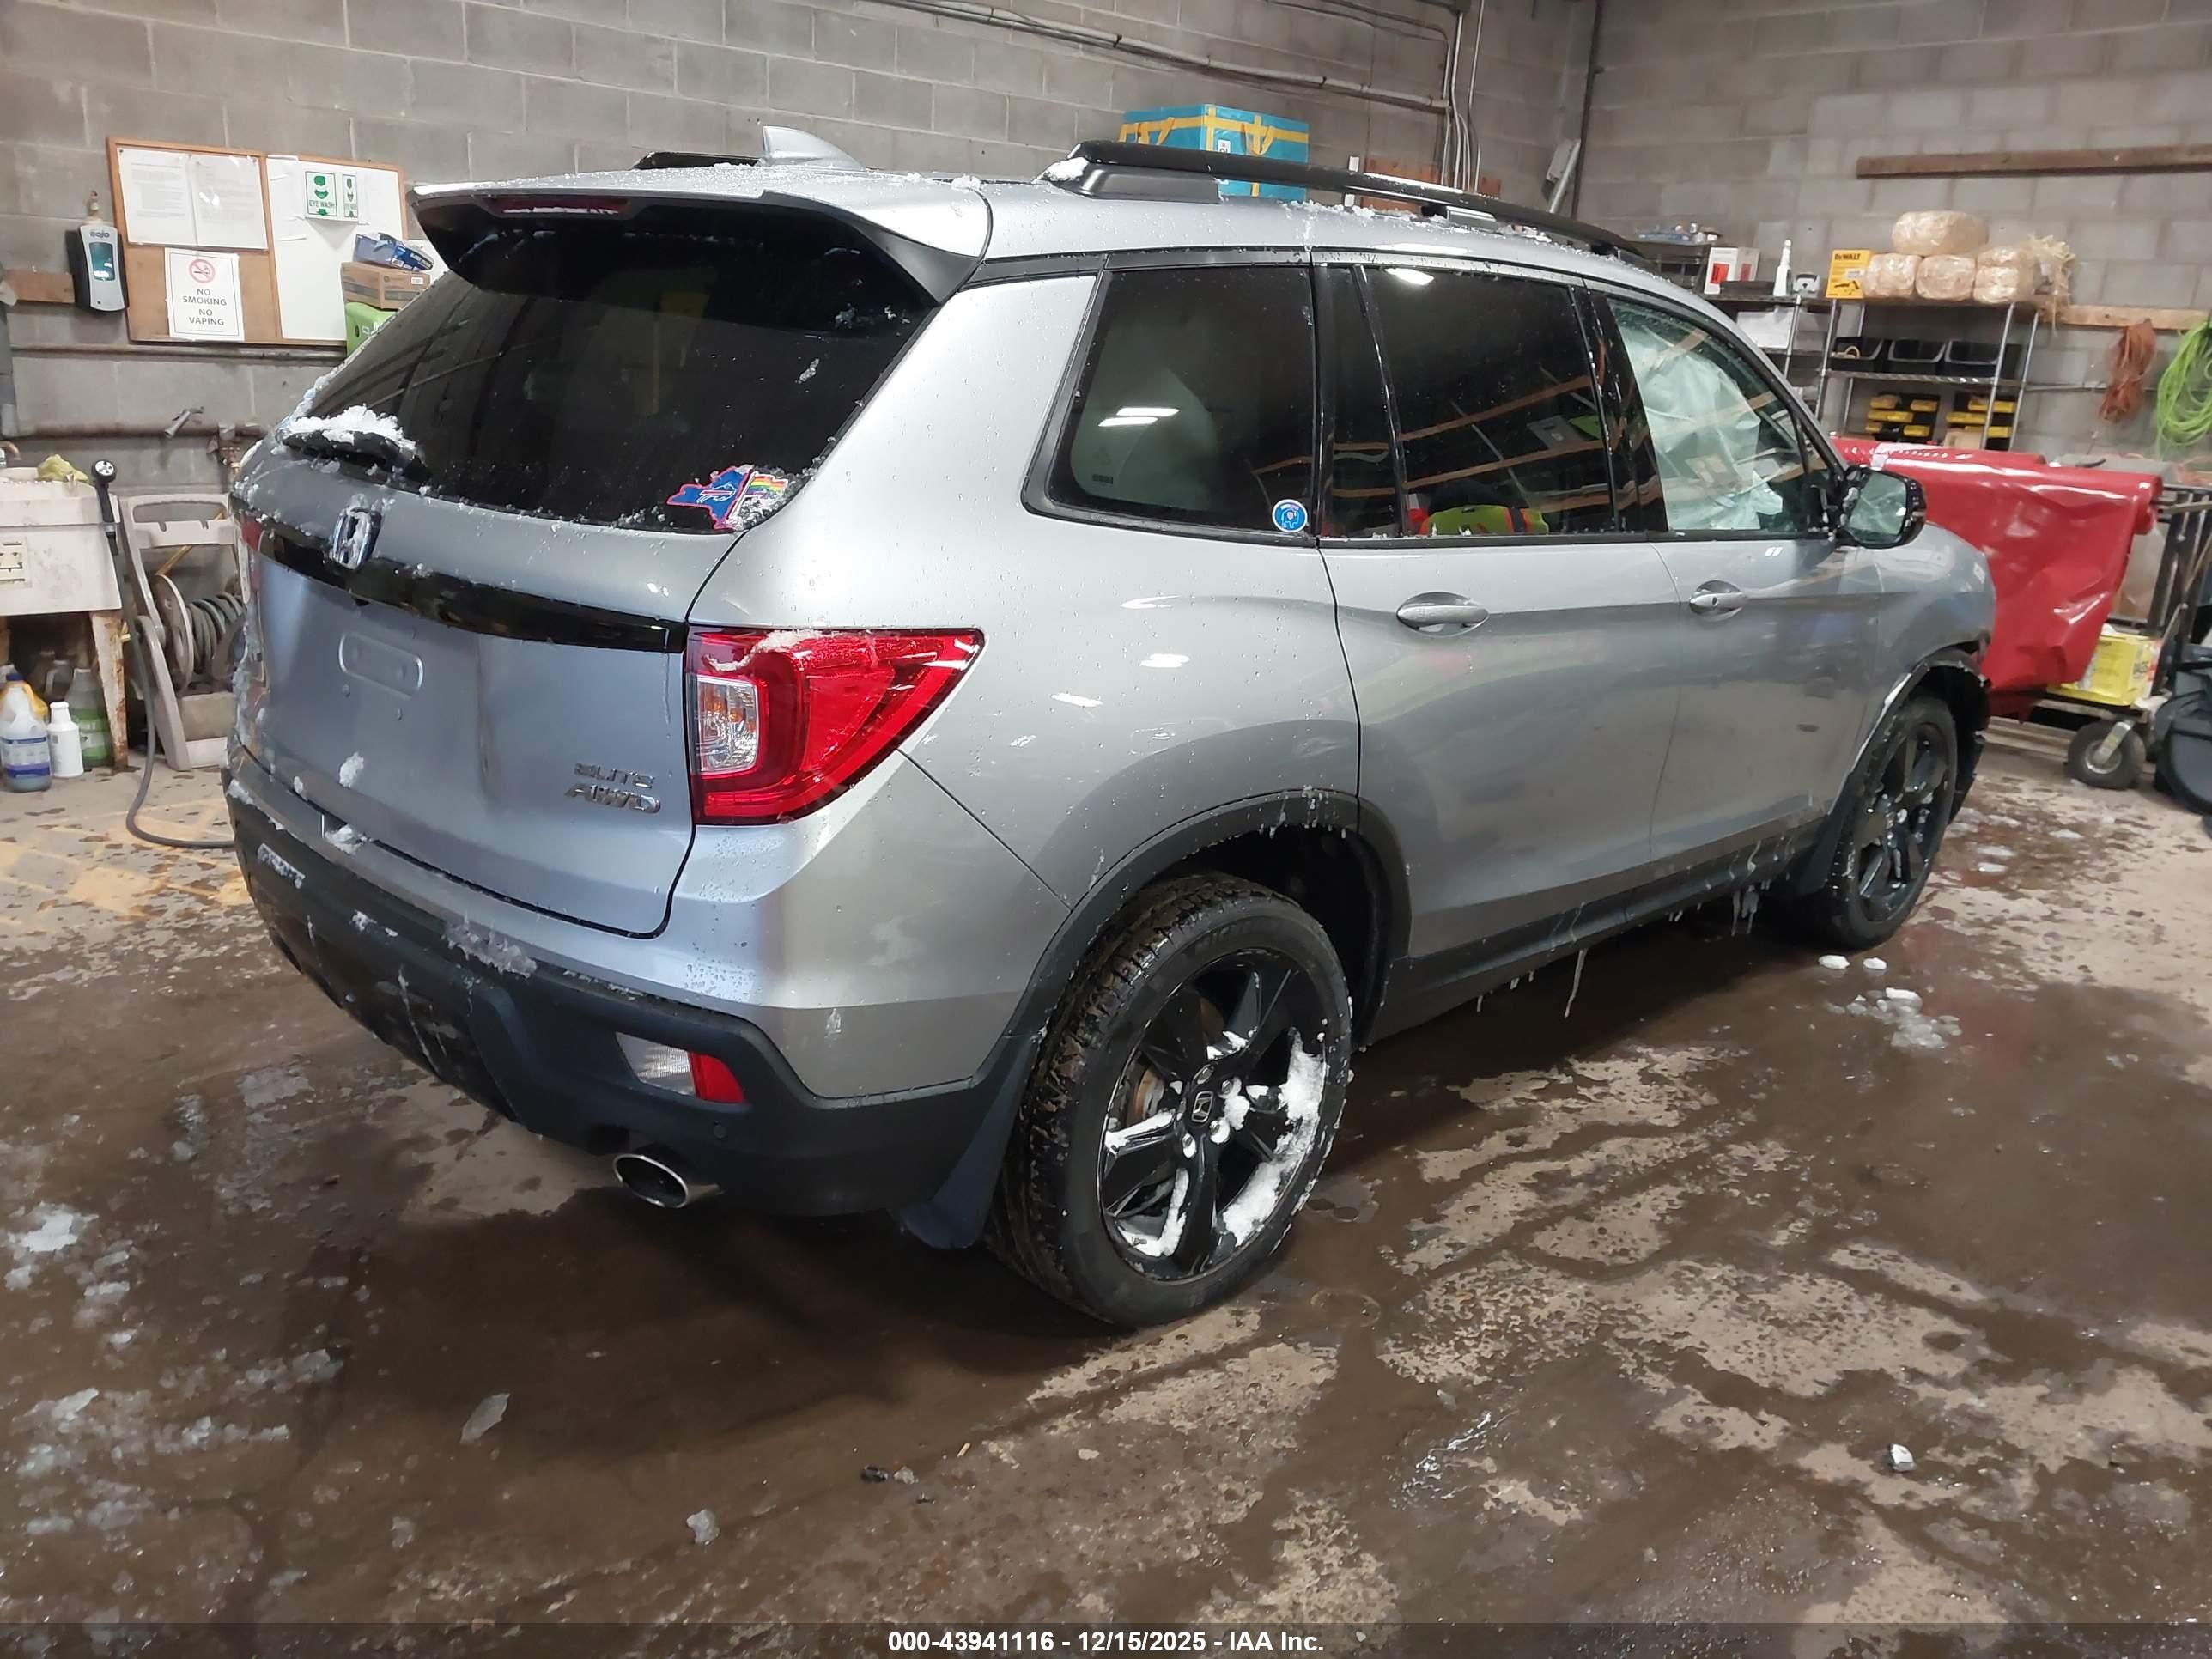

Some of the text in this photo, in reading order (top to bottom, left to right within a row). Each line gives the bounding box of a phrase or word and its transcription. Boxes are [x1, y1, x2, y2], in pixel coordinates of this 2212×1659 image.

[197, 288, 211, 296] NO
[183, 295, 228, 306] SMOKING
[198, 308, 213, 317] NO
[189, 317, 224, 325] VAPING
[574, 763, 655, 789] ELITE
[564, 784, 661, 814] AWD
